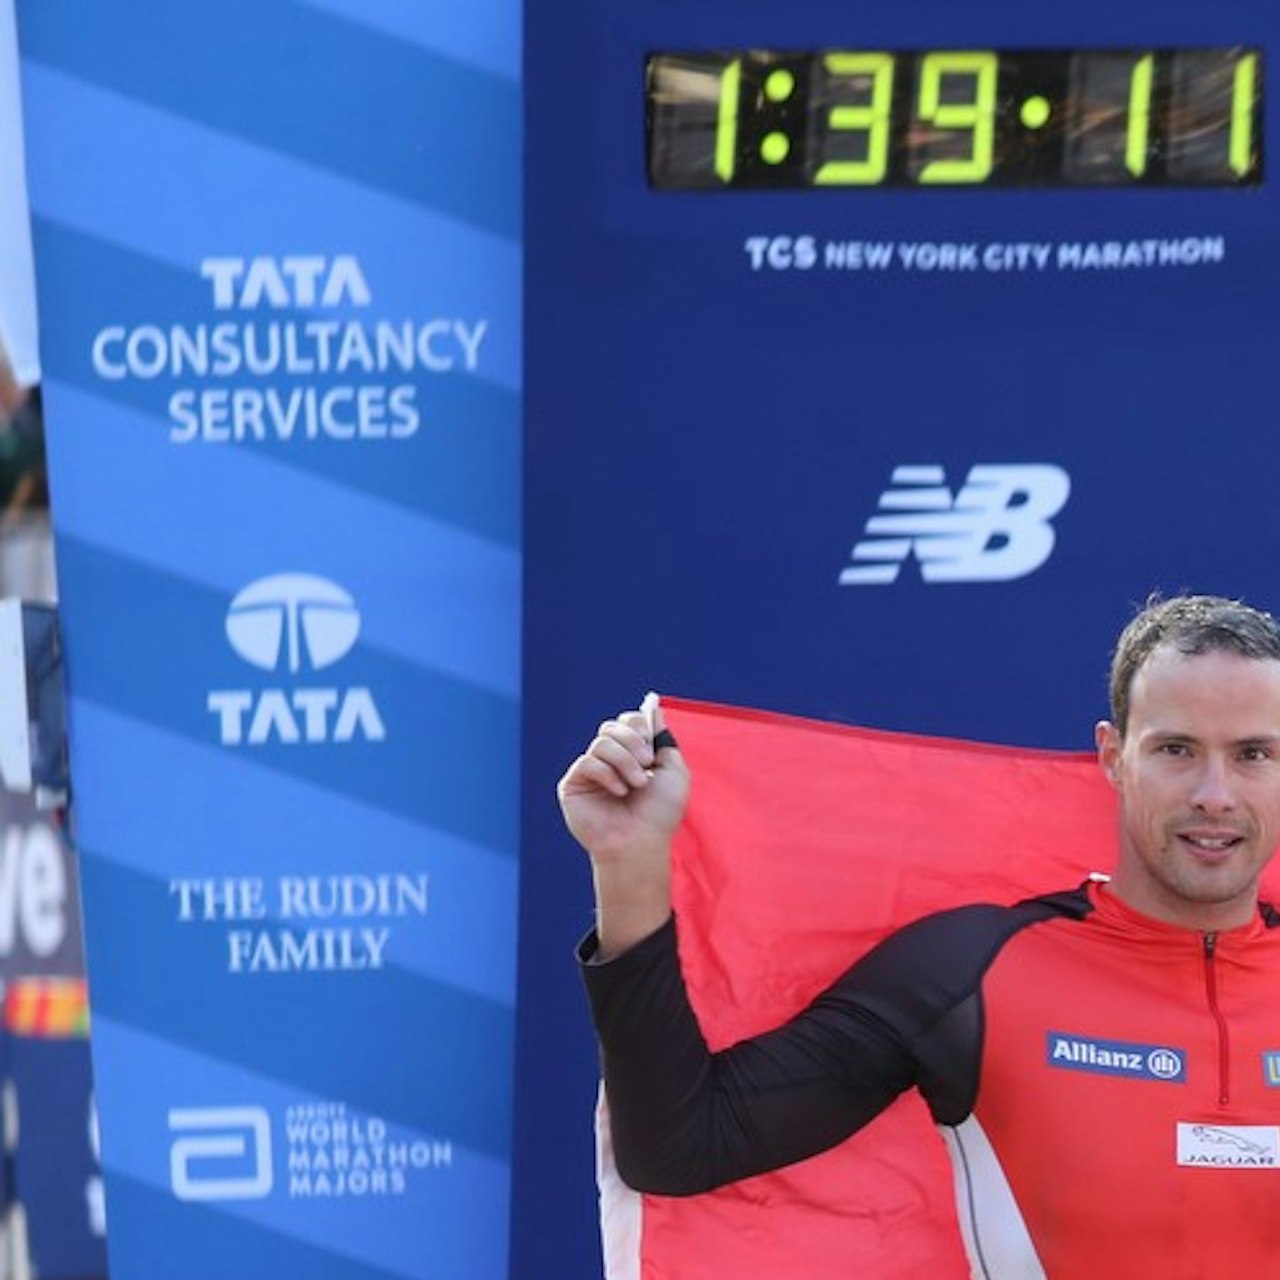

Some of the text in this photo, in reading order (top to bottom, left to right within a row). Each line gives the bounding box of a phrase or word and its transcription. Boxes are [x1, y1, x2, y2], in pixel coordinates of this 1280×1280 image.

[744, 235, 1225, 271] TCS NEW YORK CITY MARATHON
[201, 255, 371, 311] TATA
[92, 319, 488, 380] CONSULTANCY
[169, 386, 419, 443] SERVICES
[207, 687, 386, 745] TATA
[170, 873, 430, 922] THE RUDIN
[227, 926, 392, 973] FAMILY
[1054, 1038, 1144, 1071] Allianz
[286, 1118, 386, 1146] WORLD
[289, 1141, 452, 1171] MARATHON
[1184, 1154, 1276, 1166] JAGUAR
[290, 1169, 406, 1198] MAJORS
